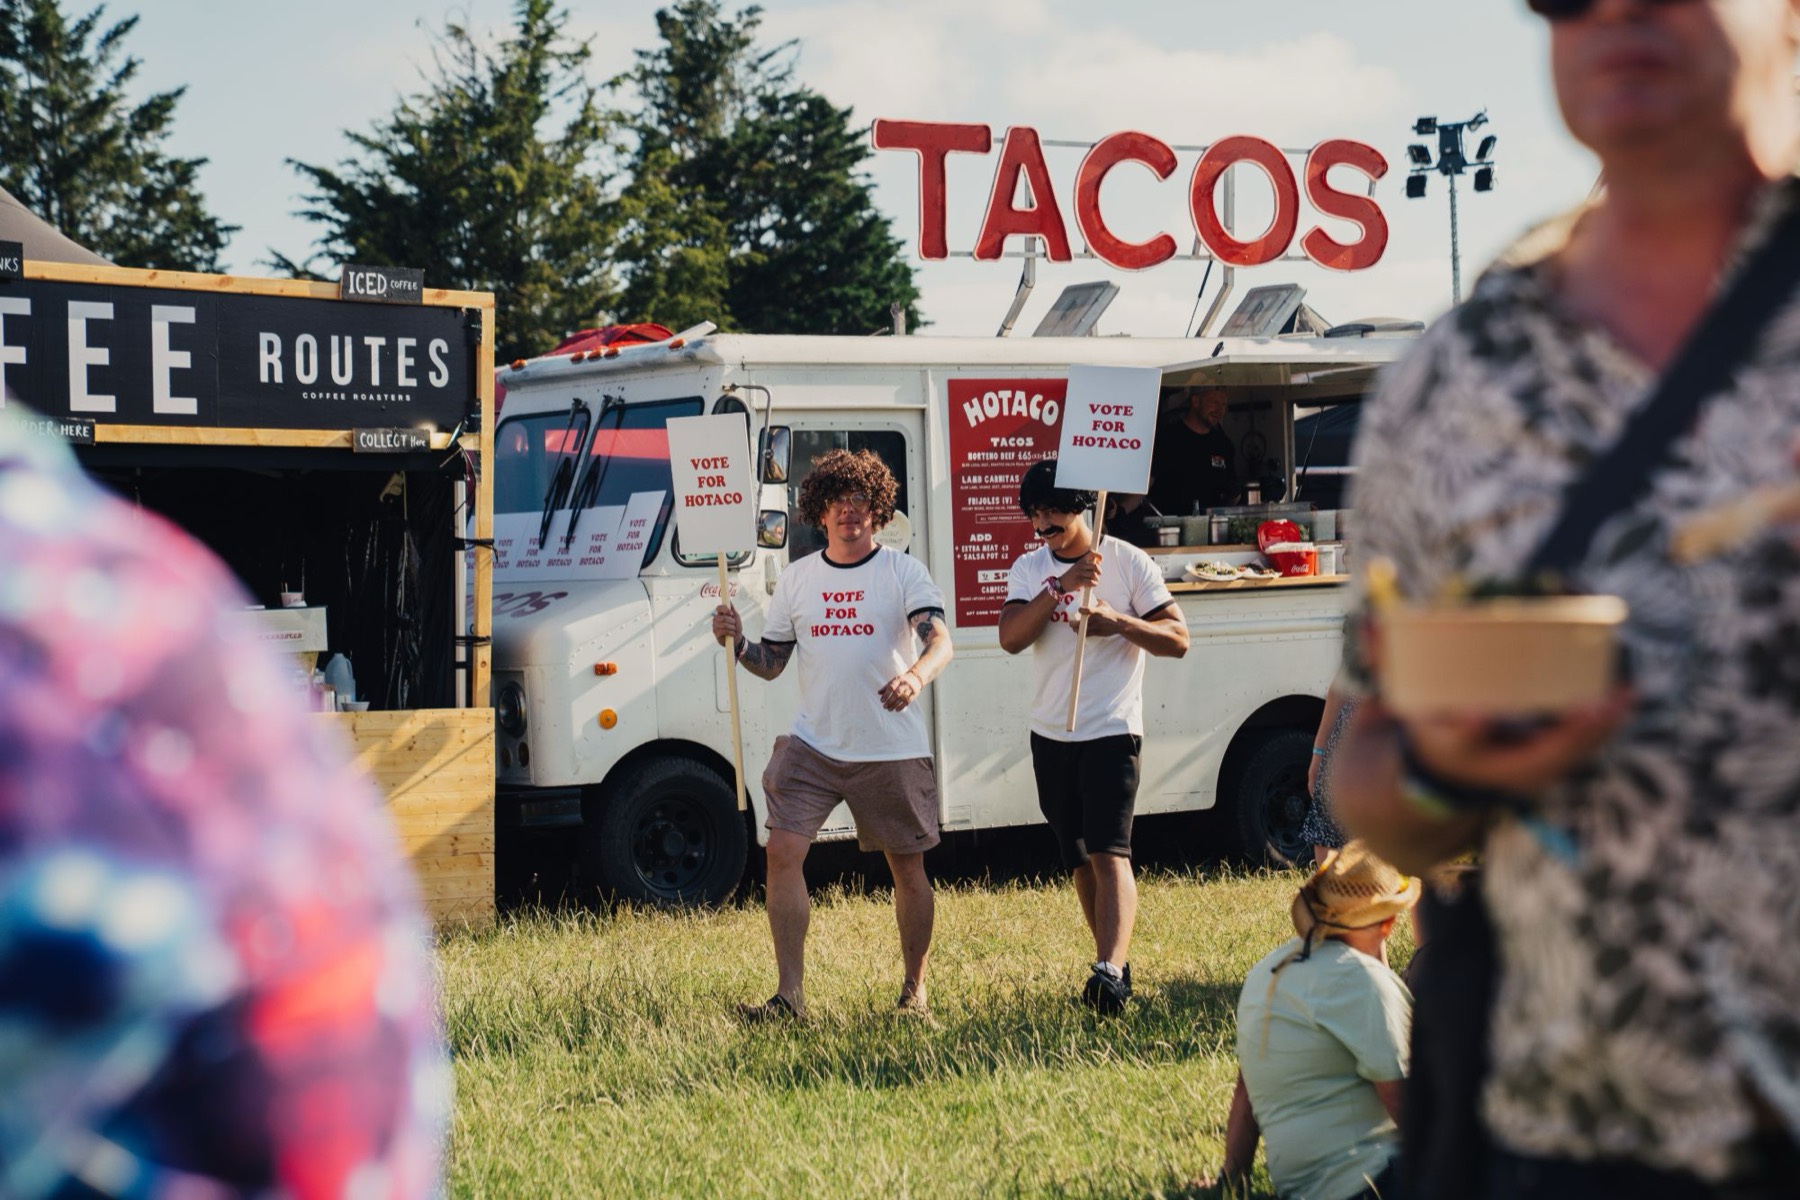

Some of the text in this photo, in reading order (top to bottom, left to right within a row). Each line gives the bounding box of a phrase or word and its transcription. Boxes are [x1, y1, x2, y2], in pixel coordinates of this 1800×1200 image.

[871, 118, 1389, 272] TACOS
[348, 271, 418, 295] ICED COFFEE
[259, 332, 449, 388] ROUTES
[302, 392, 412, 402] COFFEE ROASTERS
[962, 390, 1059, 428] HOTACO
[1089, 403, 1134, 417] VOTE
[60, 423, 91, 438] HERE
[1092, 420, 1126, 433] FOR
[360, 432, 407, 448] COLLECT
[990, 437, 1034, 447] TACOS
[1072, 435, 1141, 450] HOTACO
[690, 456, 730, 471] VOTE
[697, 474, 727, 488] FOR
[961, 475, 982, 484] LAMB
[684, 492, 743, 507] HOTACO
[629, 518, 648, 528] VOTE
[591, 533, 609, 542] VOTE
[626, 531, 641, 540] FOR
[970, 533, 993, 542] ADD
[588, 544, 603, 554] FOR
[616, 541, 644, 552] HOTACO
[525, 549, 539, 558] FOR
[963, 553, 985, 561] SALSA
[993, 571, 1010, 580] SP
[822, 590, 865, 603] VOTE
[825, 607, 857, 619] FOR
[811, 624, 875, 637] HOTACO
